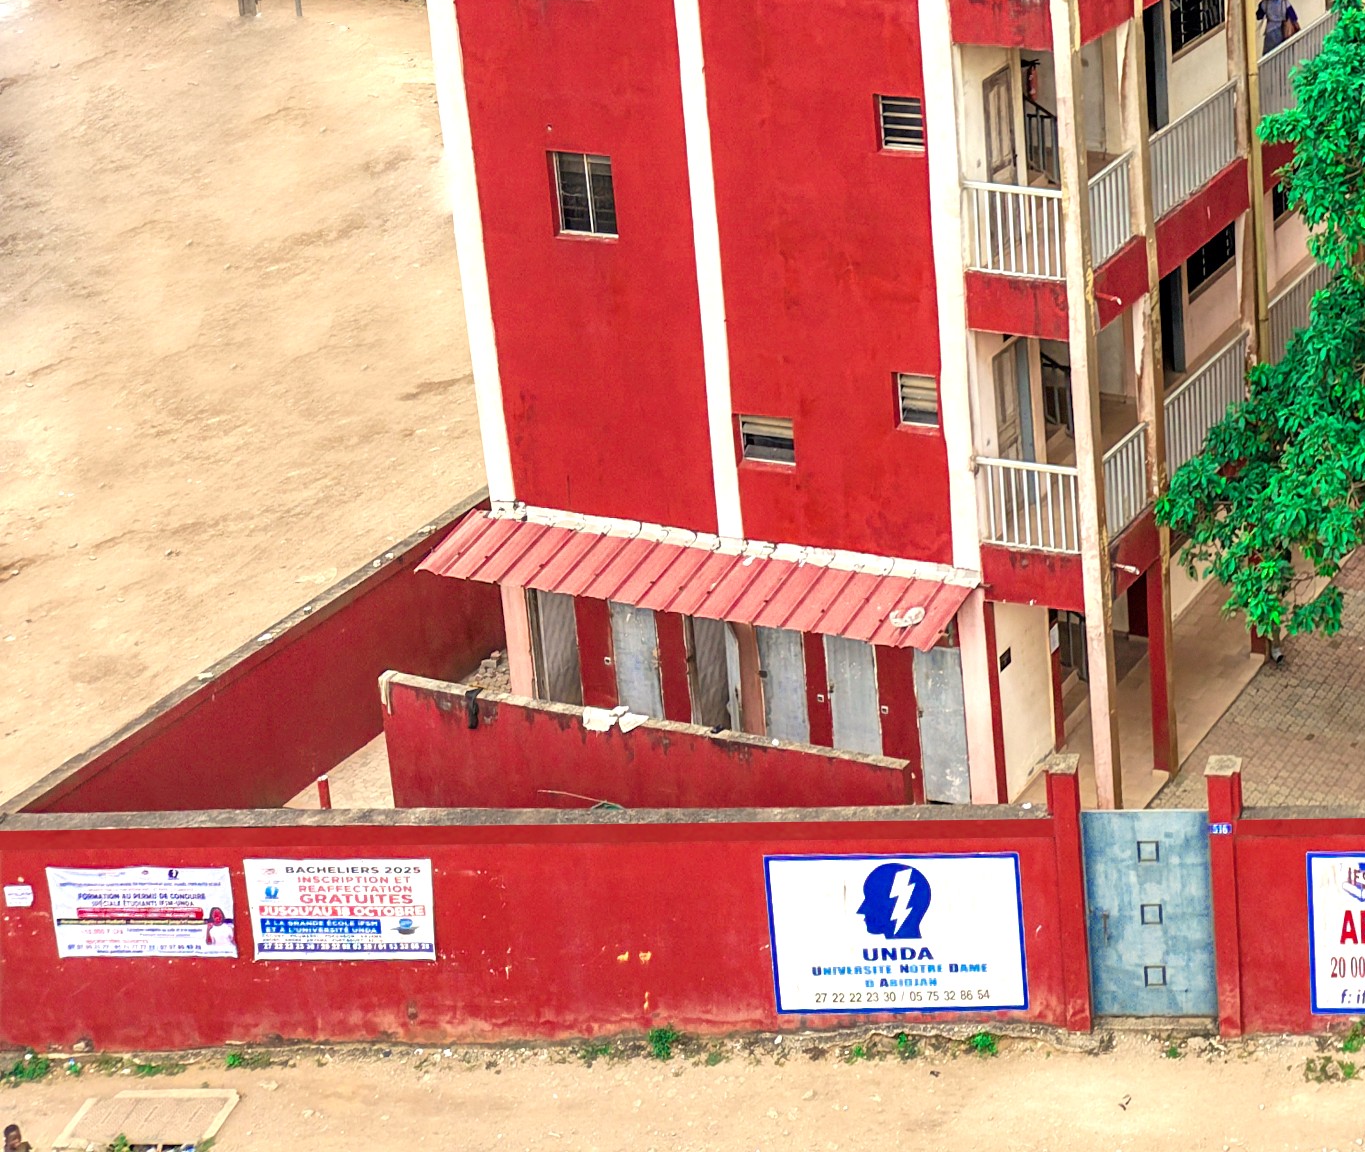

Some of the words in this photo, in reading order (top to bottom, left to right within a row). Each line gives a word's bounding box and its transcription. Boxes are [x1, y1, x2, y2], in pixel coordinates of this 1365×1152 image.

[300, 894, 413, 904] GRATUITES
[260, 906, 331, 916] JUSQU'AU
[354, 906, 425, 916] OCTOBRE
[863, 947, 934, 961] UNDA
[812, 965, 891, 976] UNIVERSITE
[900, 964, 942, 973] NOTRE
[949, 964, 987, 973] DAME
[1331, 957, 1346, 978] 20
[1351, 957, 1365, 977] 00
[880, 978, 937, 987] ABIDJAN
[816, 993, 827, 1002] 27
[833, 993, 844, 1002] 22
[850, 993, 861, 1002] 22
[867, 992, 878, 1002] 23
[884, 992, 896, 1001] 30
[910, 992, 922, 1001] 05
[928, 991, 939, 1000] 75
[944, 991, 955, 1000] 32
[961, 990, 973, 1000] 86
[978, 990, 989, 999] 54
